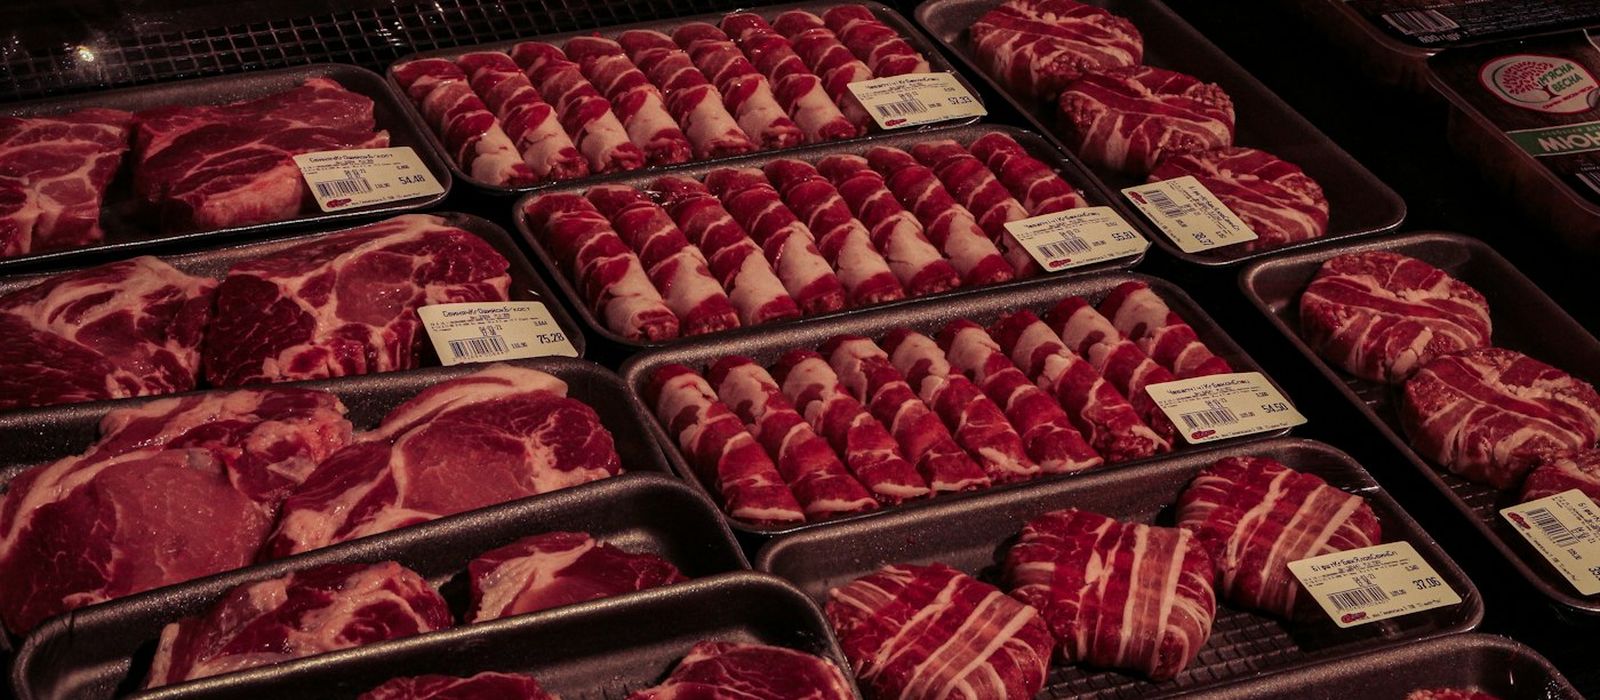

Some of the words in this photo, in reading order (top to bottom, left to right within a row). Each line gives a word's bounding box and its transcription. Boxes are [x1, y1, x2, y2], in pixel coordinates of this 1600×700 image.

[1552, 73, 1583, 92] ВЕСНА
[537, 333, 565, 345] 75.28
[1261, 402, 1289, 414] 54.50
[1412, 576, 1442, 590] 37.06
